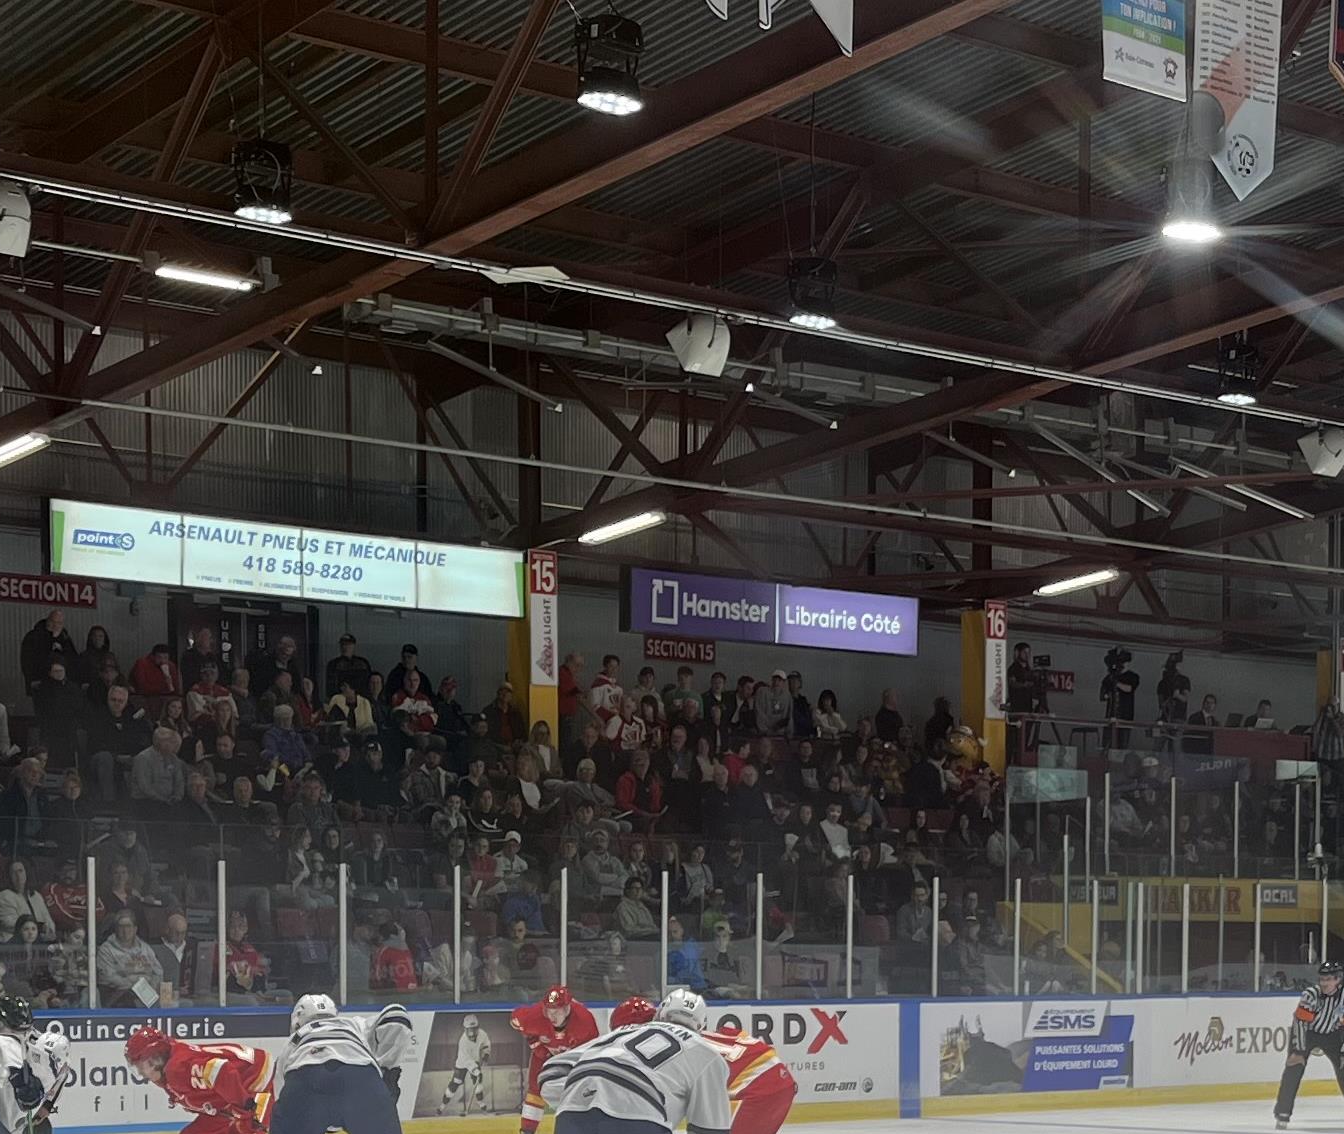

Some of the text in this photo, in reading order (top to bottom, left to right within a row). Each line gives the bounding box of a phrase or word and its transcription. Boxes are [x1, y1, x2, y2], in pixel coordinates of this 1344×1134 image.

[76, 530, 134, 550] point S
[149, 520, 447, 567] ARSENAULT PNEUS ET MÉCANIQUE
[242, 555, 363, 582] 418 589-8280
[531, 560, 555, 593] 15
[0, 576, 95, 604] SECTION 14
[682, 591, 769, 624] Hamster
[784, 605, 901, 635] Librairie Côté
[987, 608, 1005, 638] 16
[646, 638, 714, 660] SECTION 15
[1049, 1014, 1096, 1030] SMS
[1035, 1042, 1125, 1056] PUISSANTES SOLUTIONS
[190, 1063, 206, 1091] 22
[814, 1081, 857, 1092] can-am
